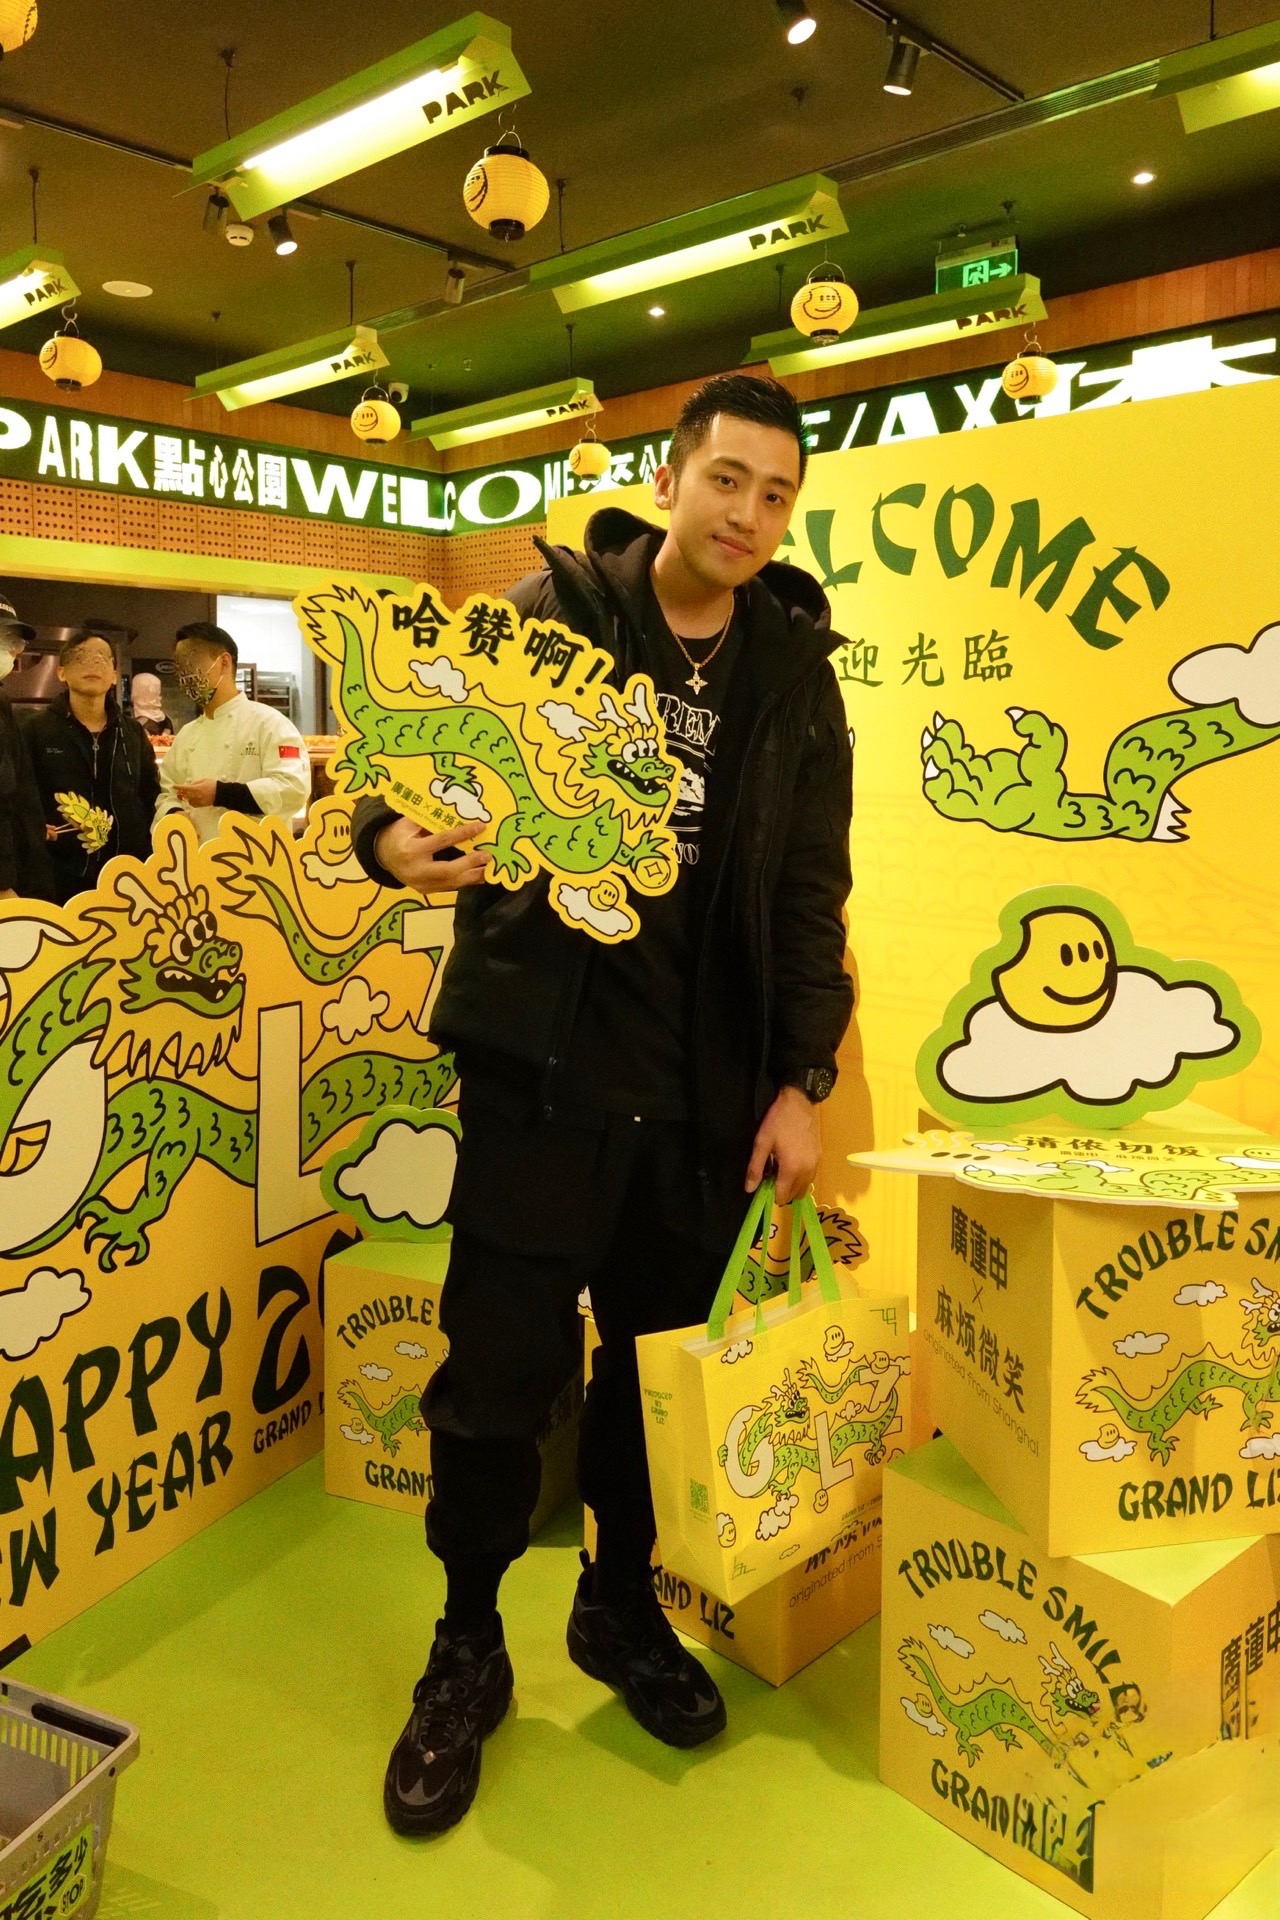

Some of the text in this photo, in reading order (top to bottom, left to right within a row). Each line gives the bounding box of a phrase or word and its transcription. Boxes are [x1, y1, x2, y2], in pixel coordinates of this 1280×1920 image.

[422, 70, 509, 124] PARK
[749, 213, 830, 250] PARK
[24, 278, 68, 306] PARK
[956, 303, 1028, 330] PARK
[330, 351, 376, 374] PARK
[546, 399, 590, 418] PARK
[153, 433, 288, 510] 點心公園
[780, 482, 1171, 651] LCOME
[1076, 1210, 1239, 1320] TROUBLE
[337, 1294, 435, 1350] TROUBLE
[934, 1284, 1026, 1414] 麻烦微笑
[923, 1328, 1040, 1459] originated from Shanghai
[253, 1400, 312, 1455] GRAND
[87, 1411, 234, 1557] YEAR
[1117, 1467, 1280, 1523] GRAND LI
[789, 1558, 847, 1608] originated
[848, 1542, 875, 1568] from
[898, 1538, 1037, 1600] TROUBLE
[700, 1592, 735, 1640] LIZ
